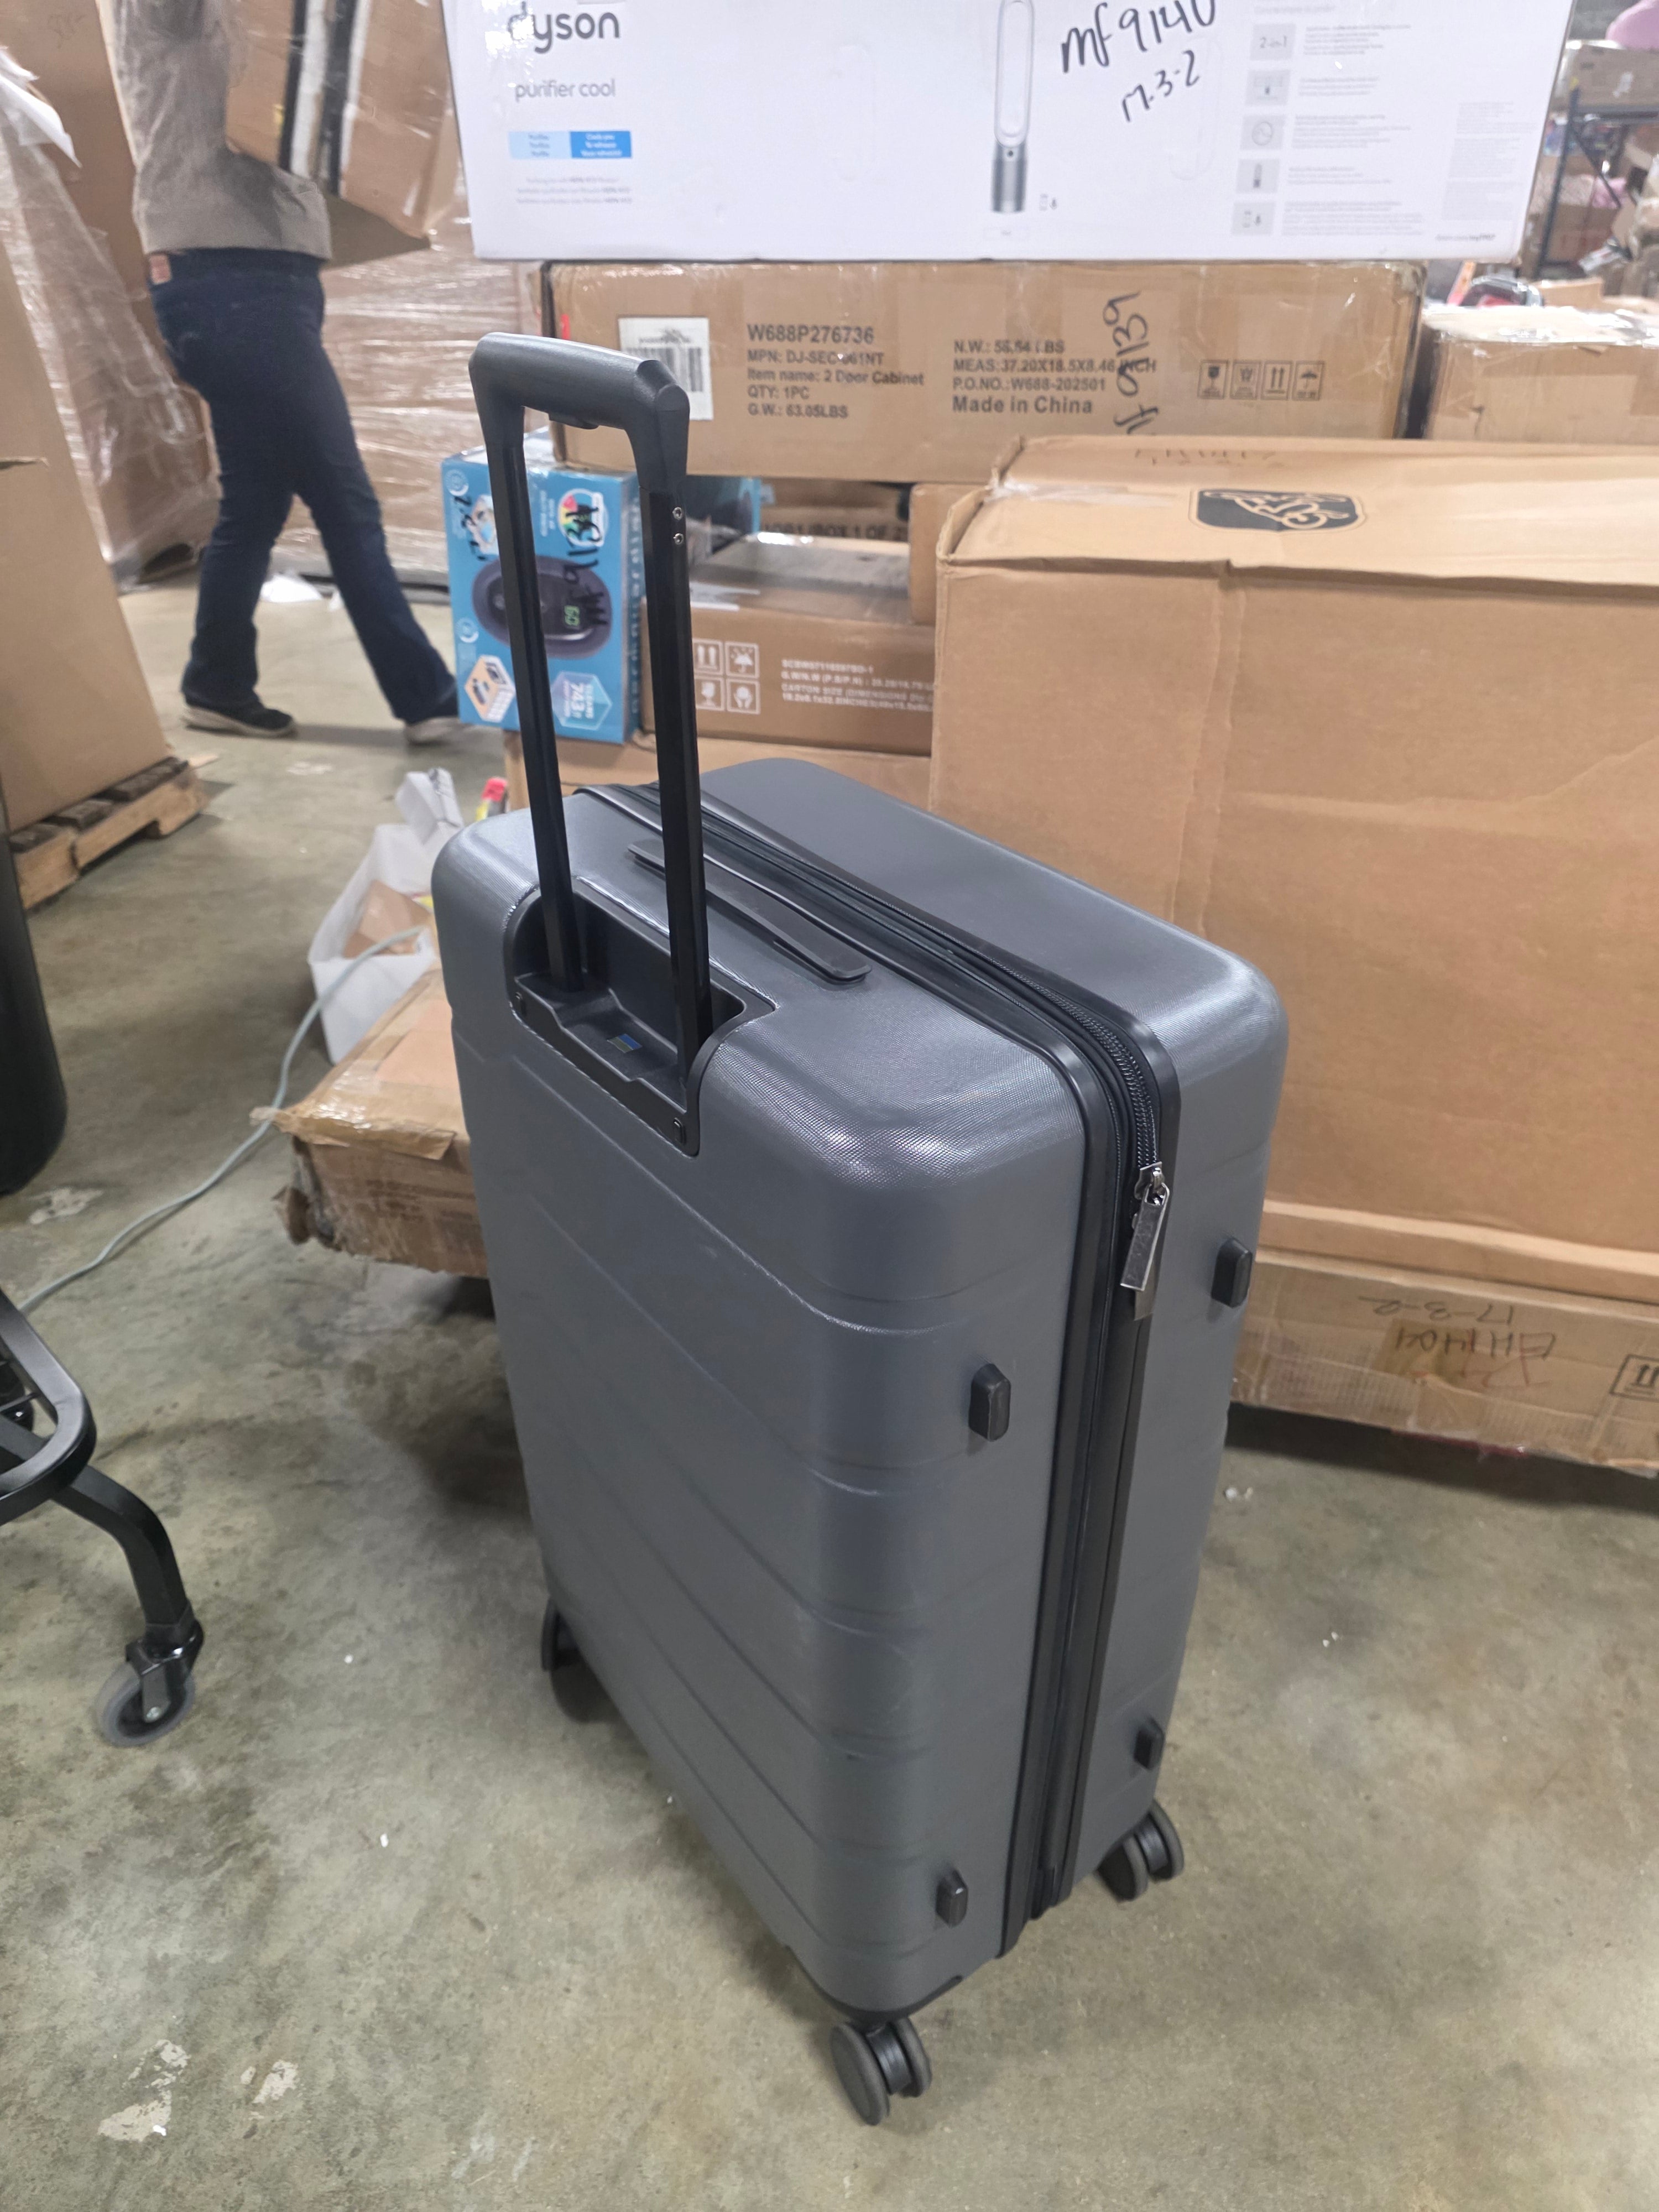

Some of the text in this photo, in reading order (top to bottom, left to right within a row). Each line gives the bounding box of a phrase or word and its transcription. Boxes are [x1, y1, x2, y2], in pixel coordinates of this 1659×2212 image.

[515, 79, 615, 103] purifier cool
[747, 324, 875, 344] W688P276736
[824, 370, 833, 383] 2
[836, 369, 869, 384] Door
[872, 371, 925, 385] Cabinet
[747, 384, 810, 400] QTY: 1PC
[952, 395, 1093, 414] Made in China
[570, 683, 585, 711] 743
